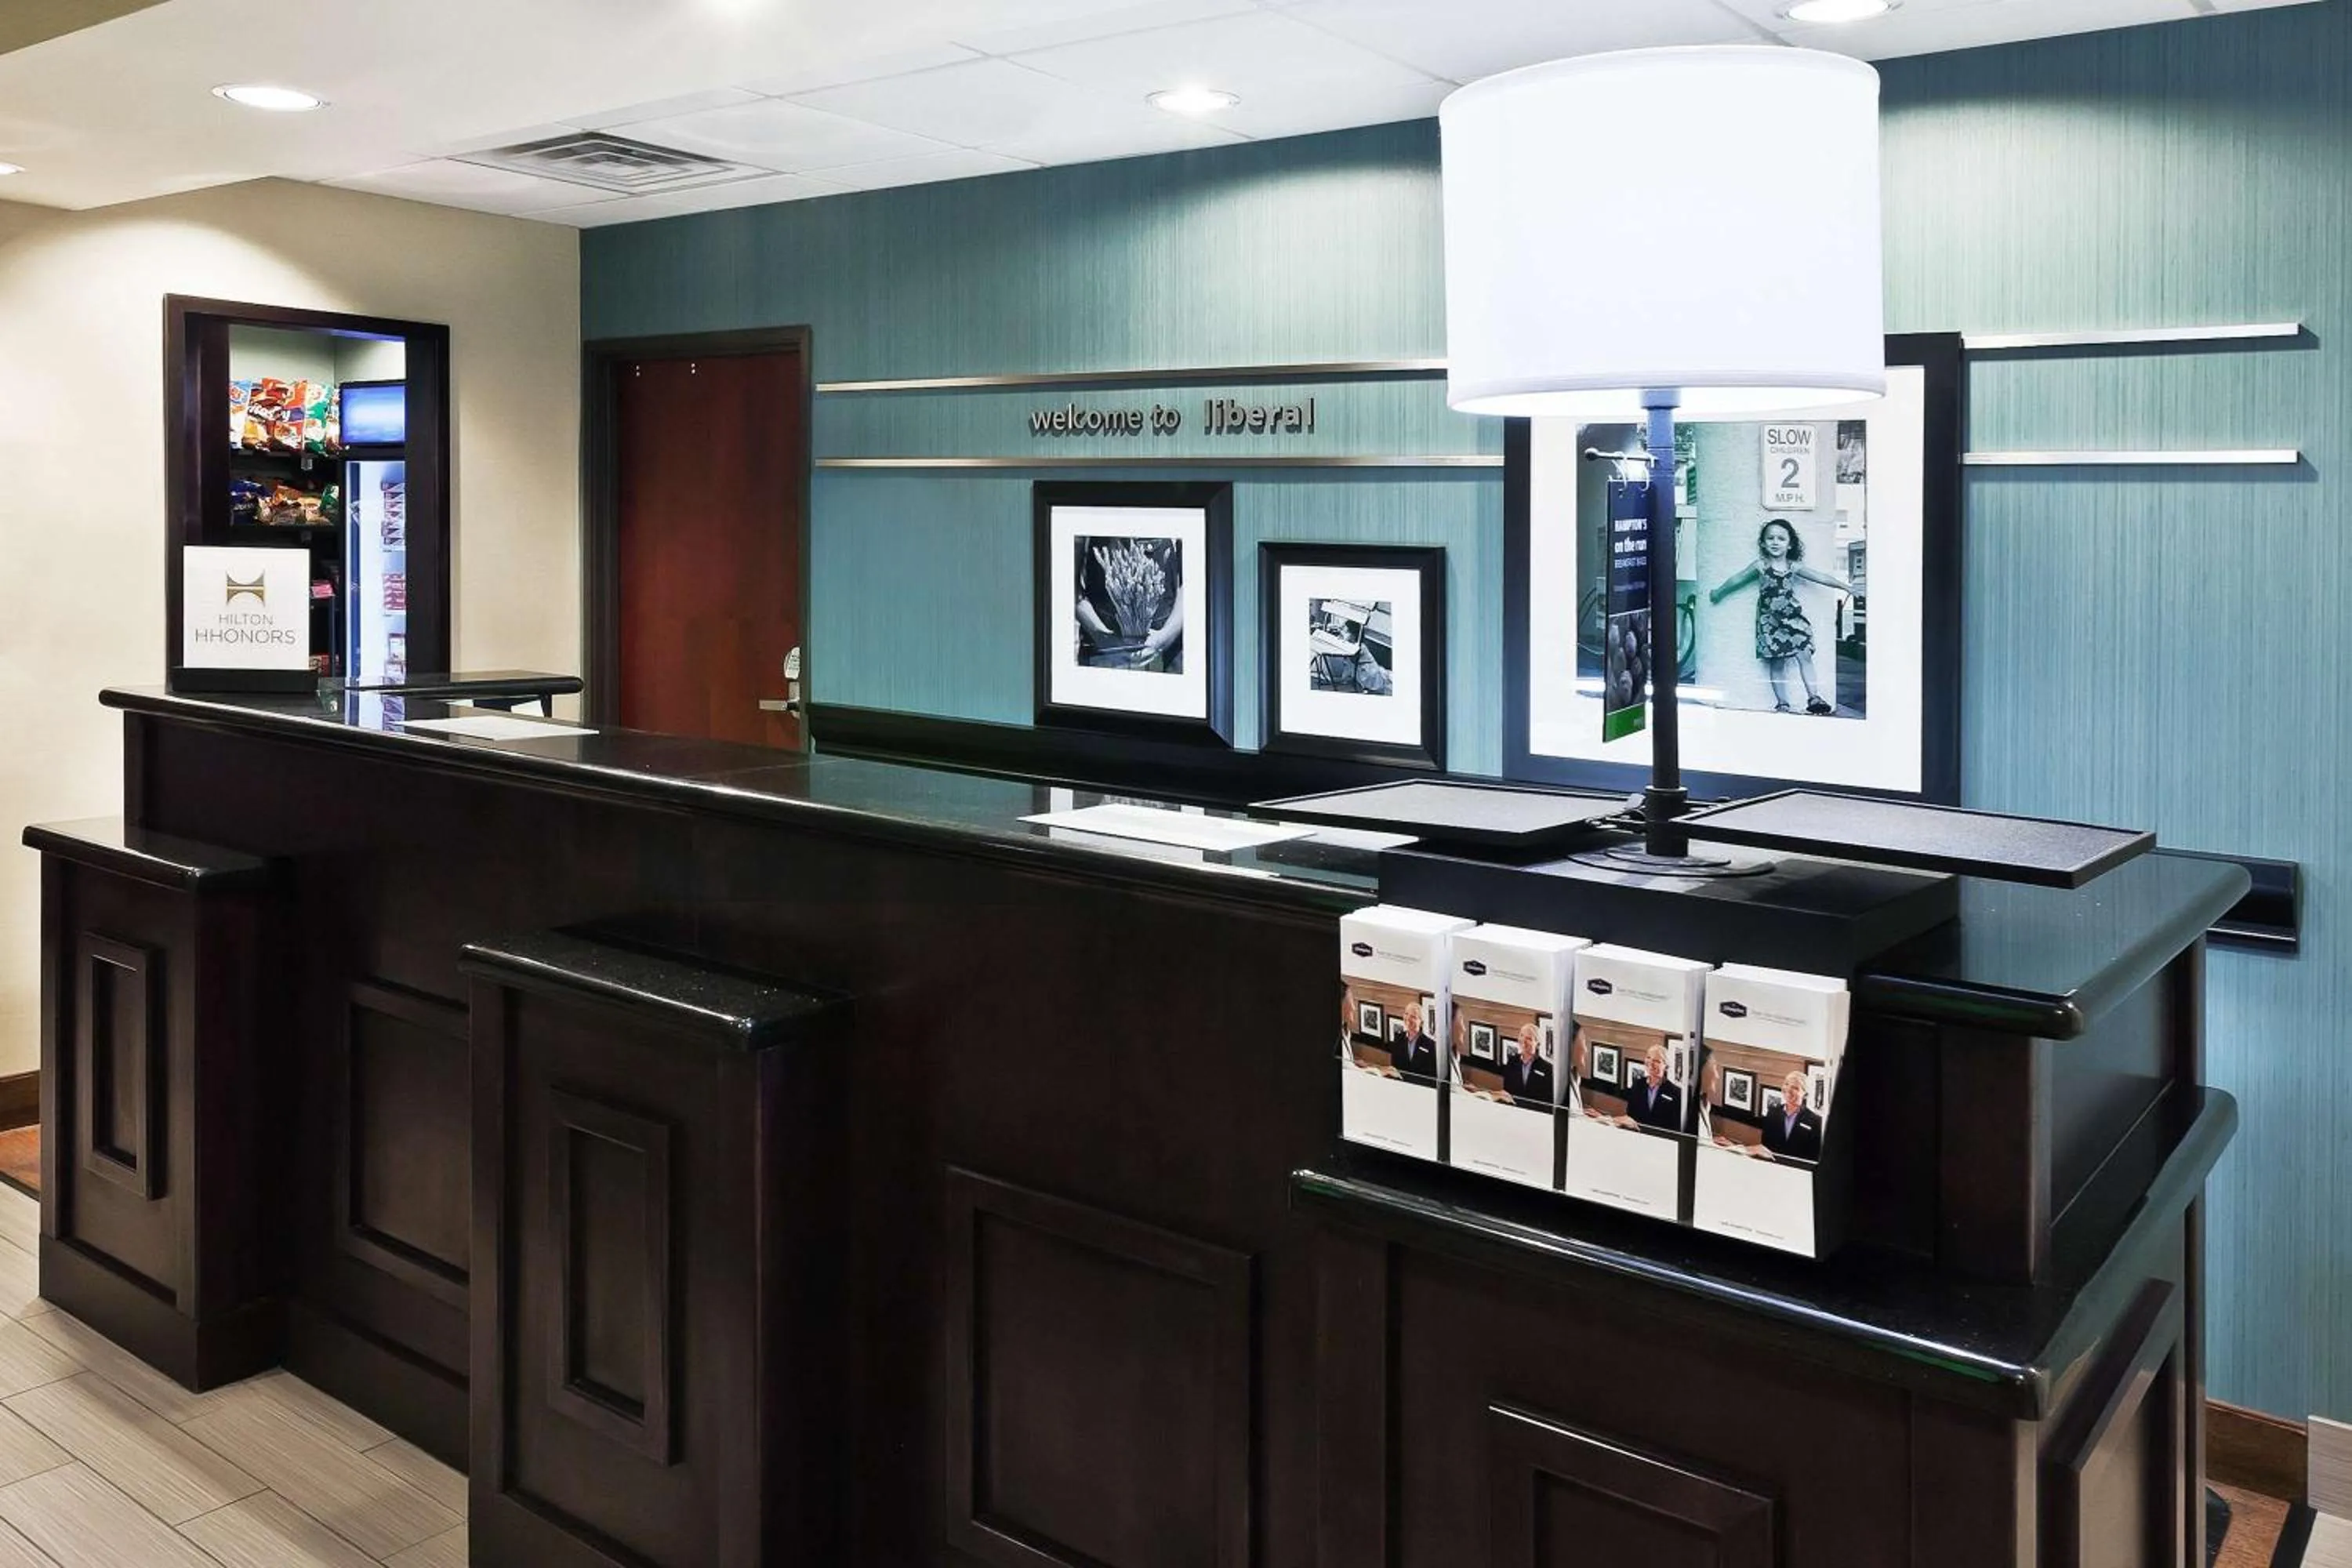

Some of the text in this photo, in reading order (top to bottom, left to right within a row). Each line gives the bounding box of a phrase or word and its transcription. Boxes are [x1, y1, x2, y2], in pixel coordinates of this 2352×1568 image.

[1029, 397, 1316, 437] welcome to liberal
[1767, 429, 1811, 445] SLOW
[1780, 458, 1800, 488] 2
[218, 614, 274, 626] HILTON
[194, 628, 296, 644] HHONORS
